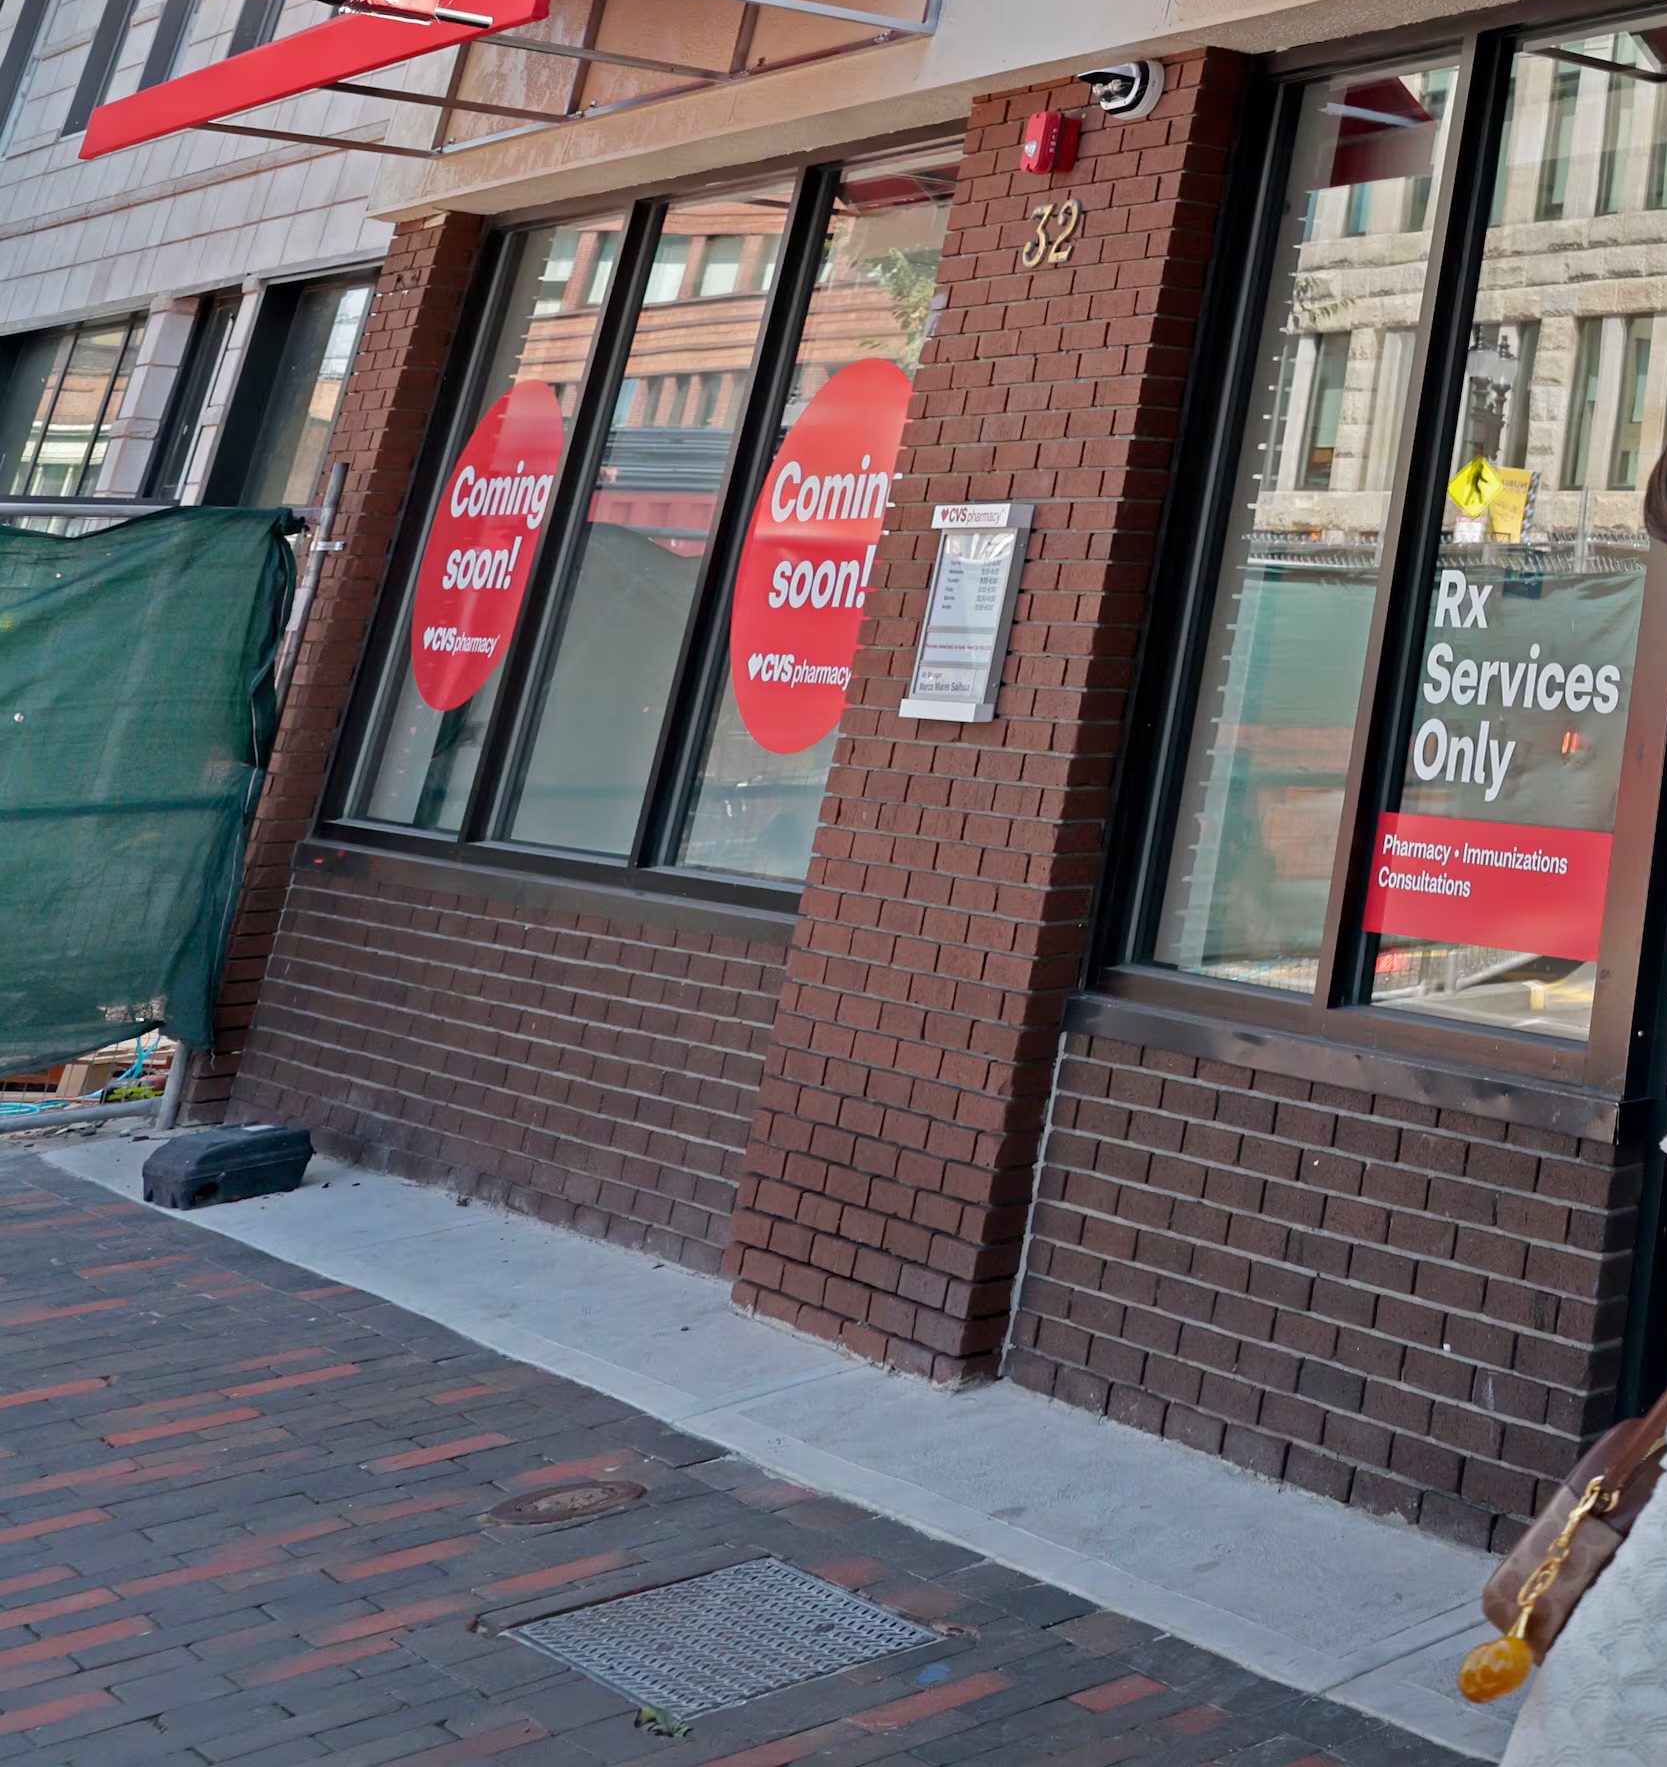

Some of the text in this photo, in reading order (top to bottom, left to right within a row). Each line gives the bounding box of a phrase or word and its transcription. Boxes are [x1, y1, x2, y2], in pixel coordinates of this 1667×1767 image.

[1022, 197, 1082, 268] 32
[450, 460, 555, 530] Coming
[770, 454, 894, 525] Comin
[949, 507, 1001, 525] CVS pharmacy
[442, 535, 523, 590] soon!
[768, 544, 877, 609] soon!
[1434, 569, 1494, 629] Rx
[431, 627, 498, 658] CVS pharmacy
[760, 653, 852, 692] CVS pharmacy
[1422, 643, 1622, 714] Services
[1413, 718, 1517, 803] Only
[1378, 868, 1471, 899] Consultations
[1382, 834, 1568, 876] Pharmacy Immunizations
